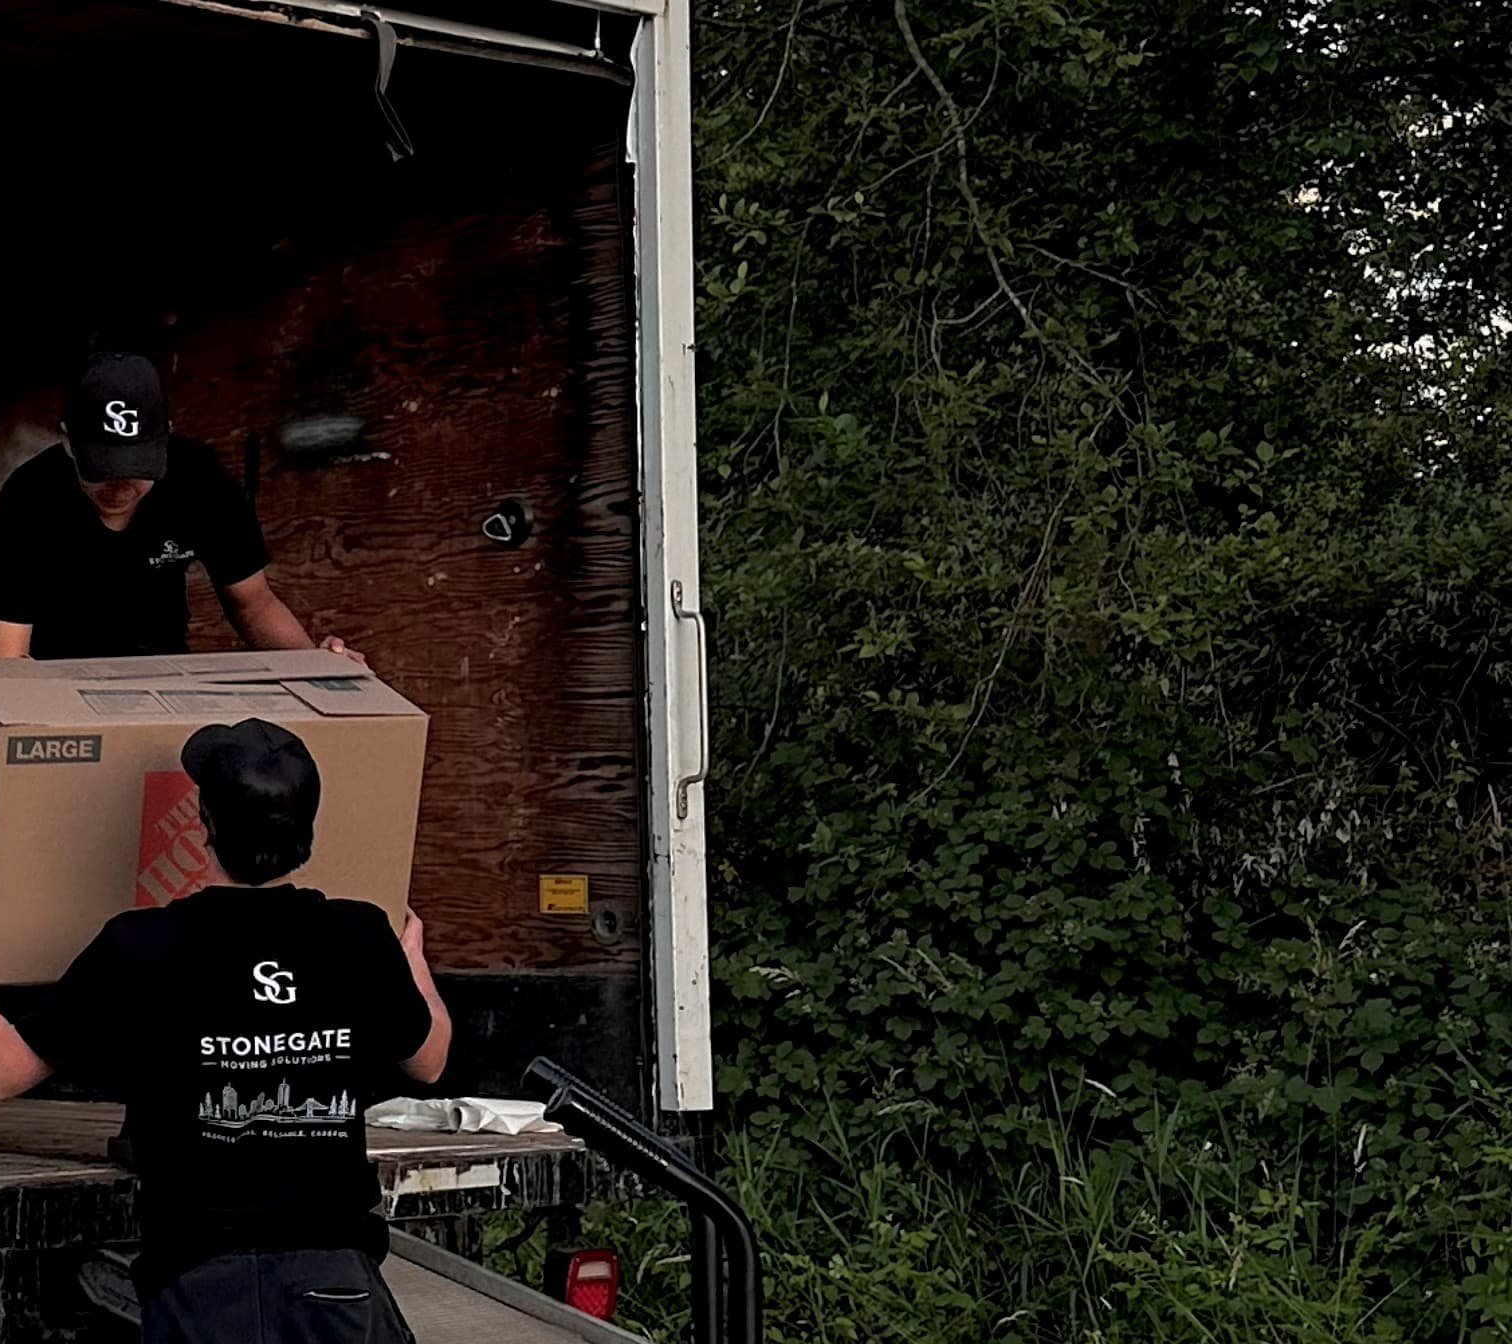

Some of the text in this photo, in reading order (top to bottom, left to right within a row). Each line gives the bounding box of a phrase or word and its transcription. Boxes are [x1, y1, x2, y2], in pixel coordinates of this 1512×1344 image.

[103, 400, 139, 437] SG
[15, 740, 93, 759] LARGE
[253, 961, 297, 1004] SG
[200, 1028, 351, 1056] STONEGATE
[220, 1053, 331, 1070] MOVING SOLUTIONS
